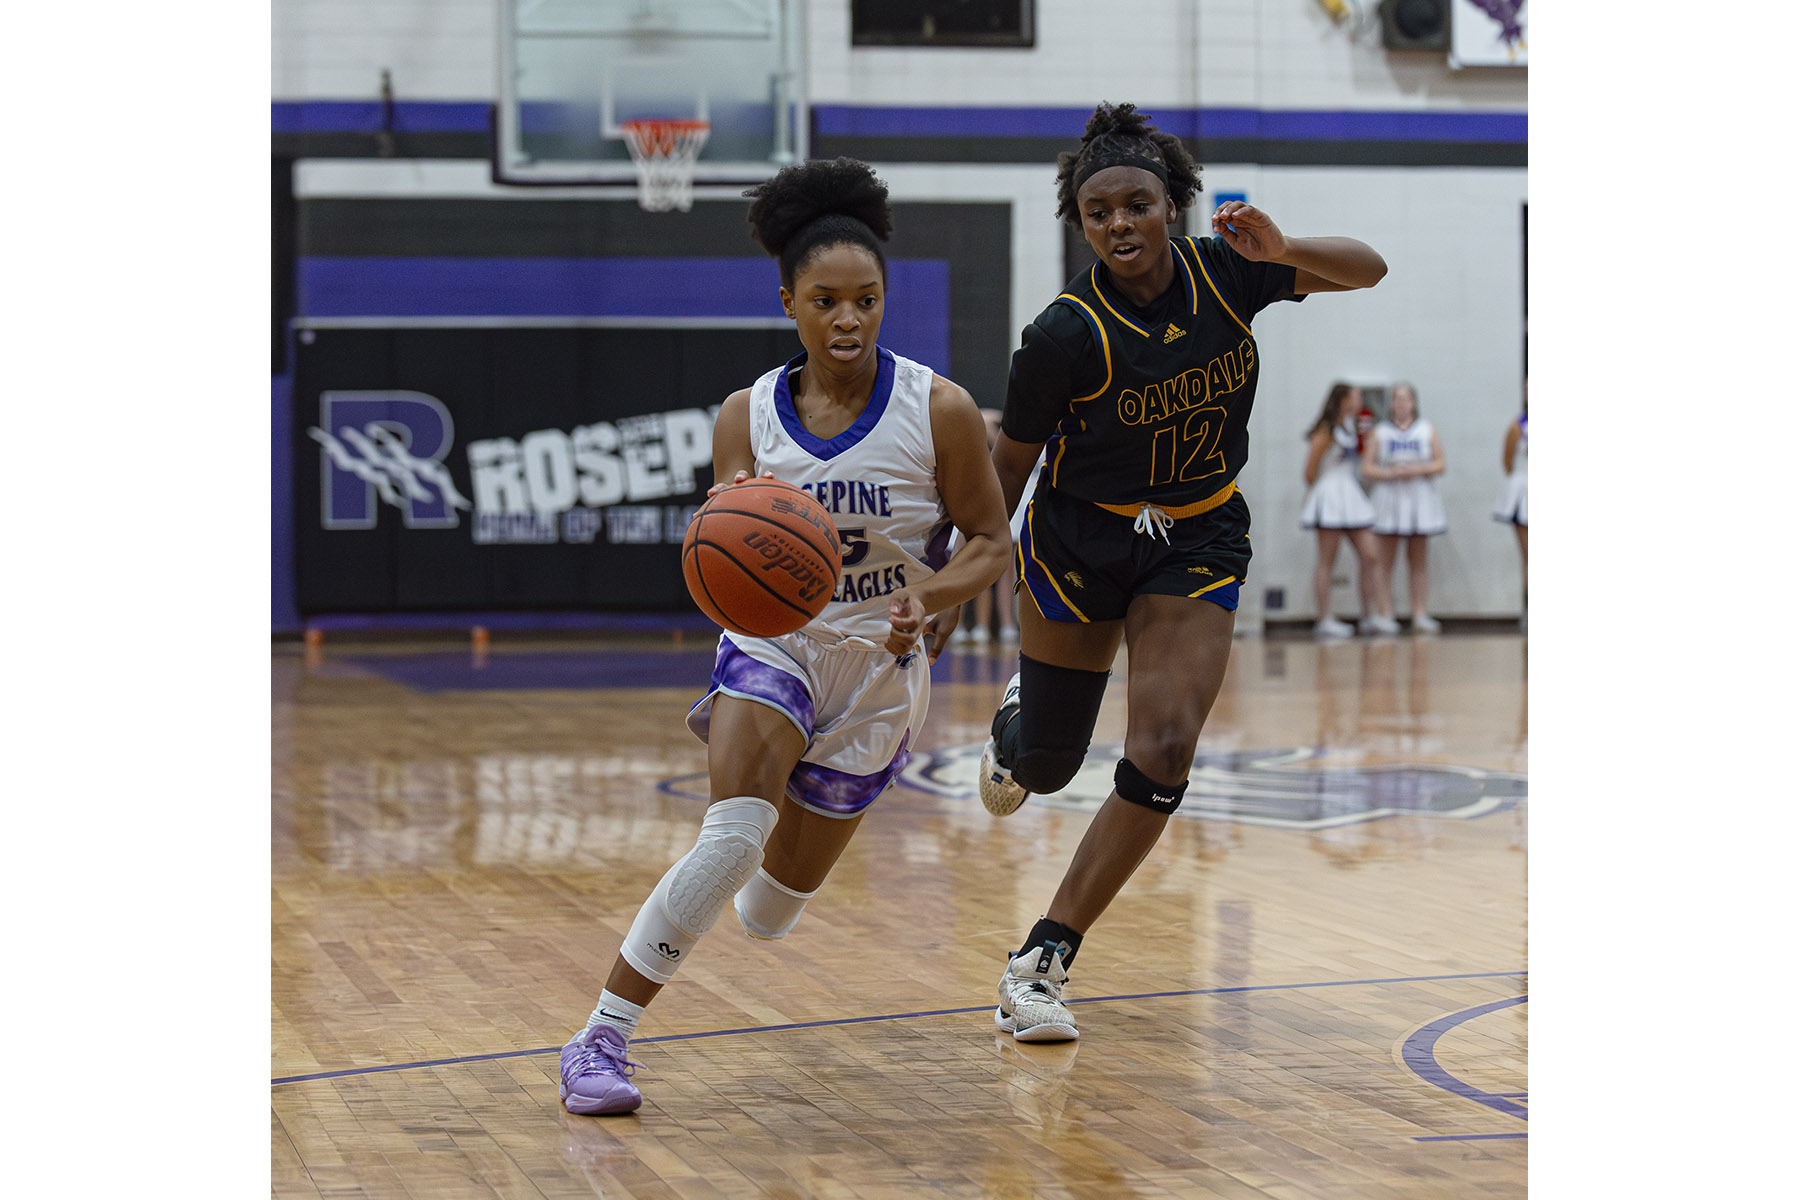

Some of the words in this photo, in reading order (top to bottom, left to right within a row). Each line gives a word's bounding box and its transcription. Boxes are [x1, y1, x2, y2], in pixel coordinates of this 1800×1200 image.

[1163, 329, 1187, 344] adidas
[1117, 338, 1255, 426] OAKDALE
[466, 405, 718, 514] ROSEP
[1150, 406, 1228, 486] 12
[743, 531, 829, 603] Baden
